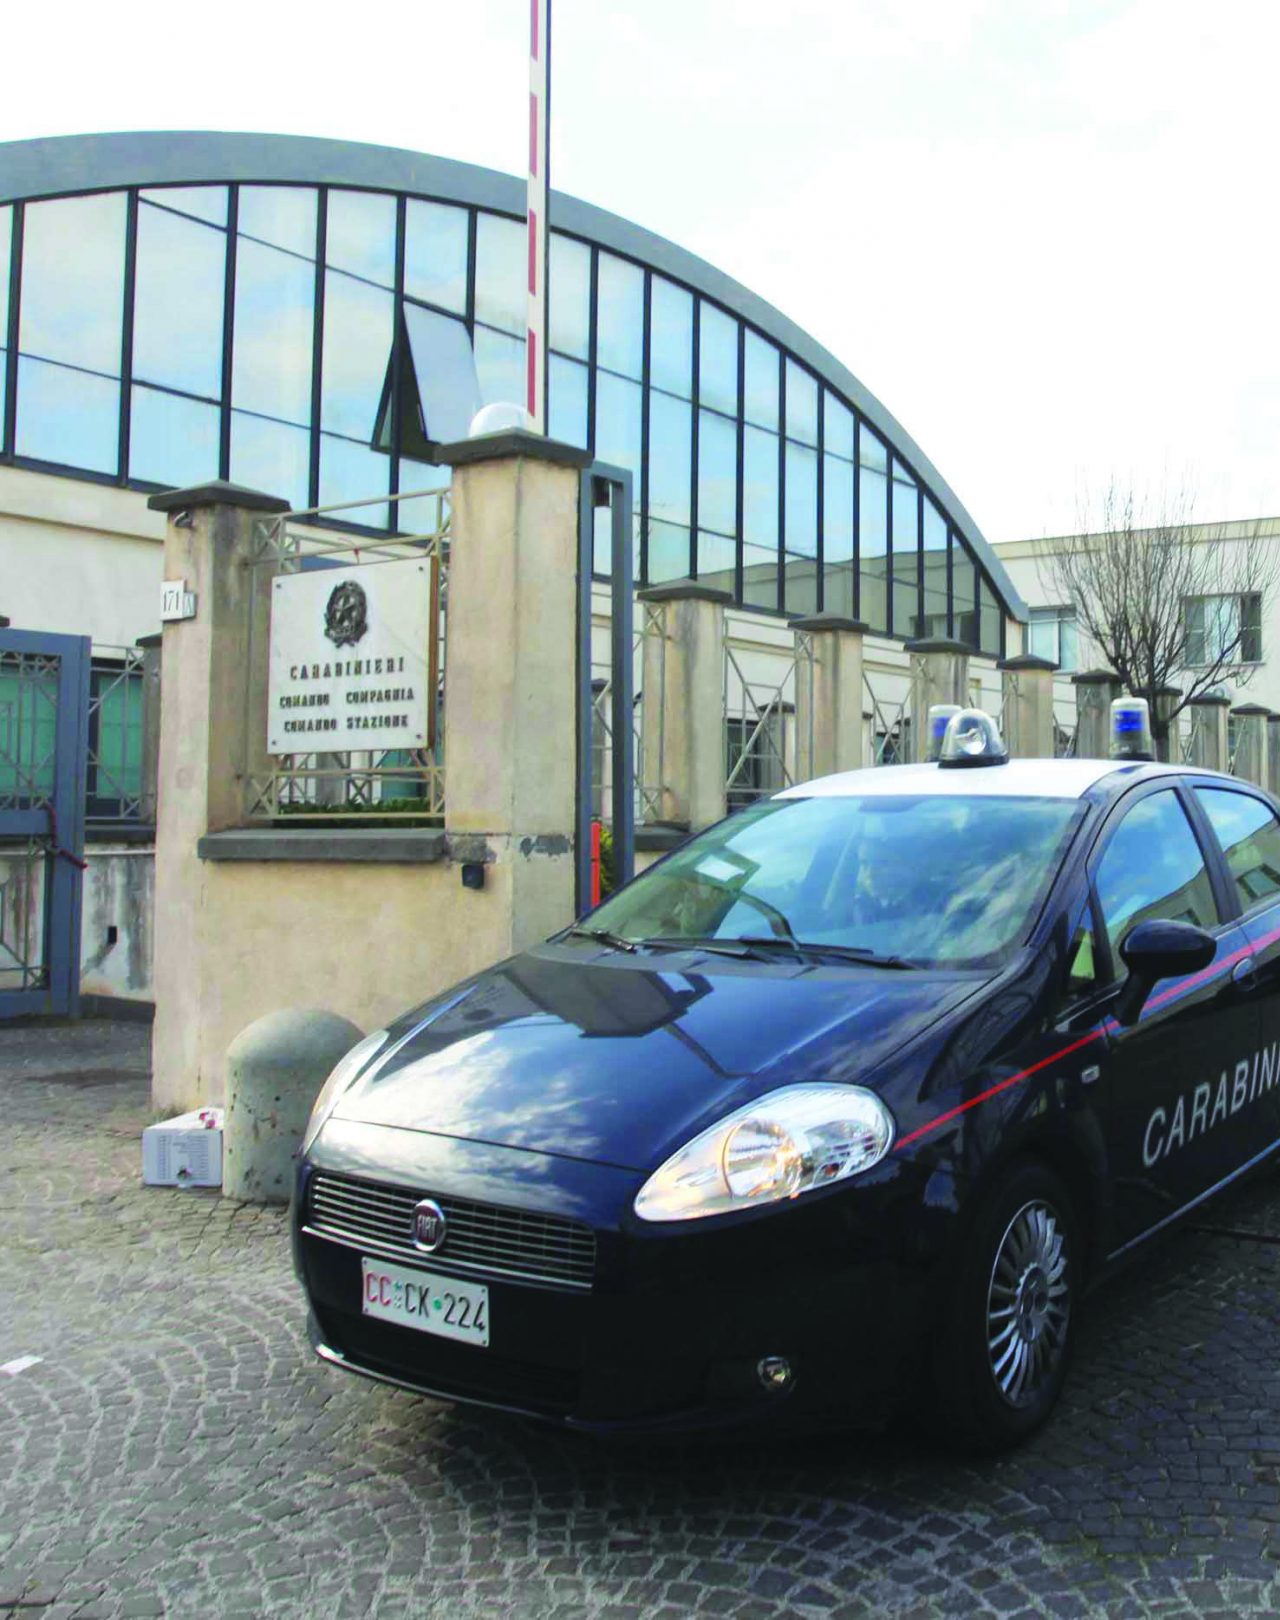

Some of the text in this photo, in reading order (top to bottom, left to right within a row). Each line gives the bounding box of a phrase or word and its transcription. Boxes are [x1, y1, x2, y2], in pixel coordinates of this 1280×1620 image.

[163, 590, 179, 611] 171
[290, 657, 404, 680] CARABINIERI
[280, 688, 414, 708] COMANDO COMPAGNIA
[284, 714, 408, 733] COMANDO STAZIONE
[416, 1214, 437, 1239] FIAT
[365, 1272, 485, 1332] CC CK 224
